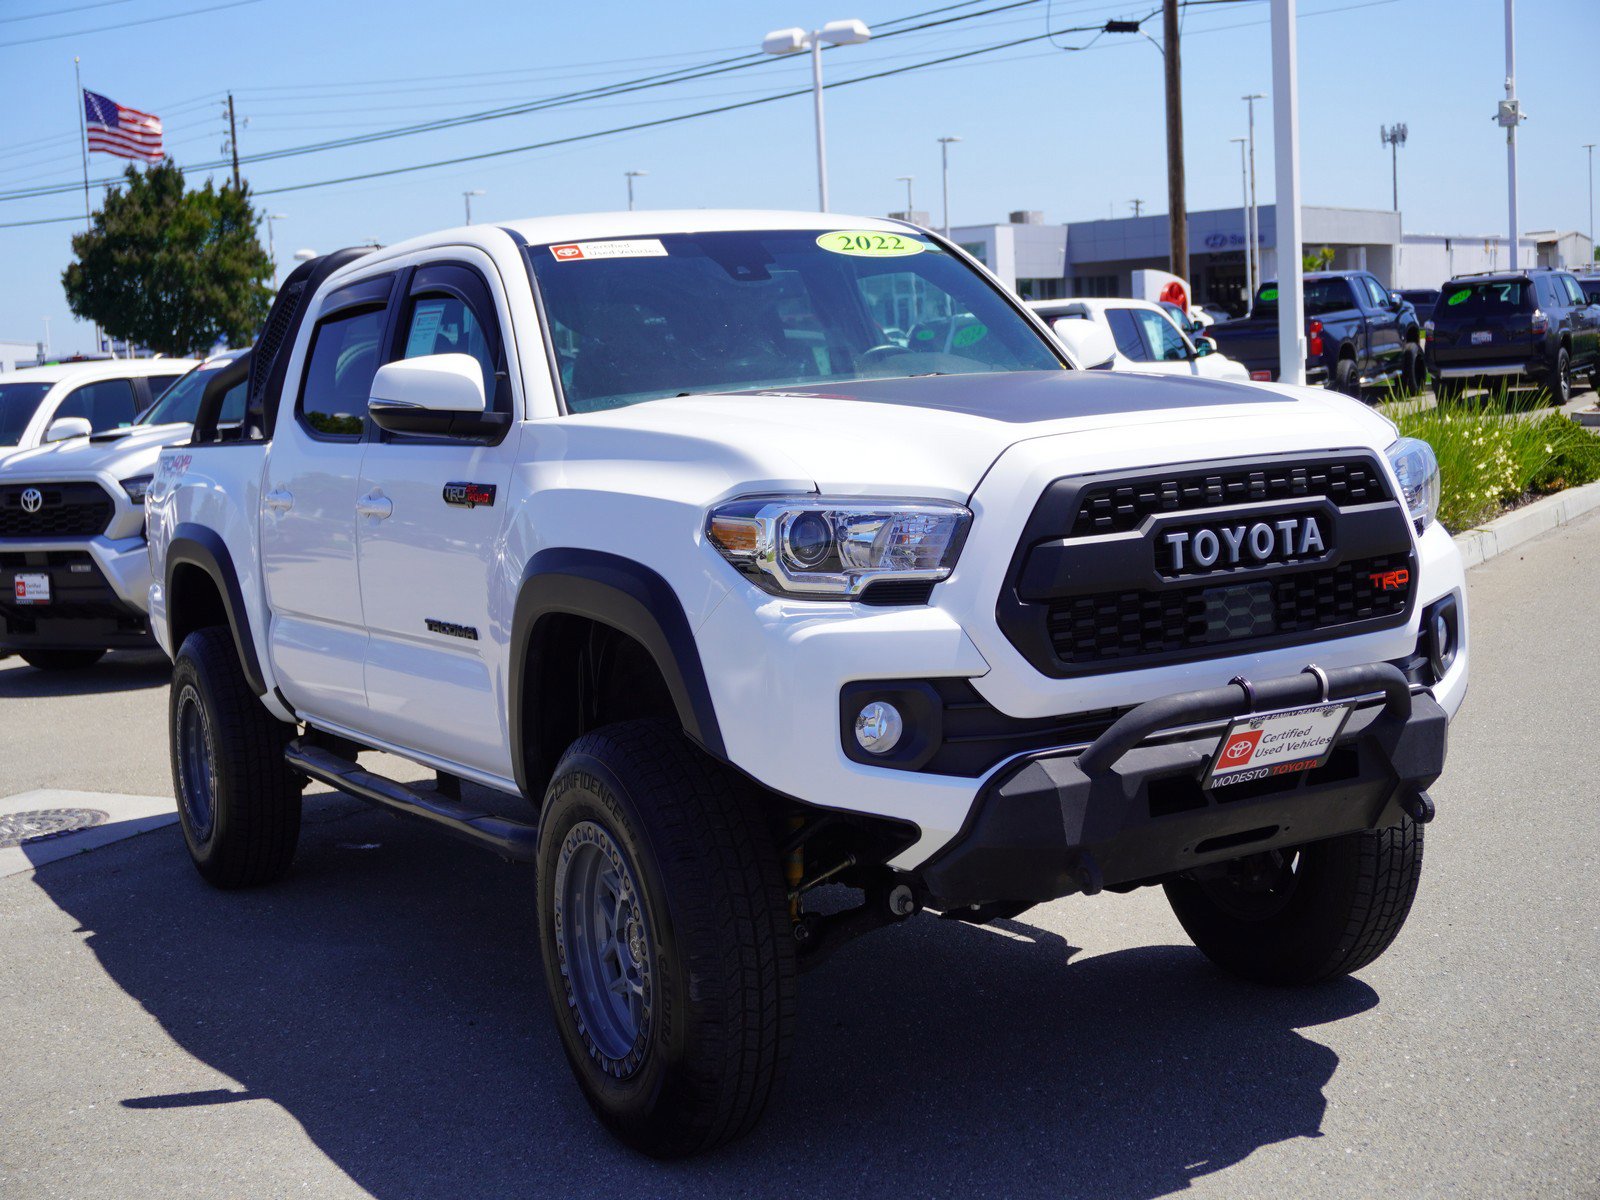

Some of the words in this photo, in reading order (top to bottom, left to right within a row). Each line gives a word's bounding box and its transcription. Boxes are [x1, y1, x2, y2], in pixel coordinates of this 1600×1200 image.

[837, 235, 905, 250] 2022
[444, 485, 466, 502] TRD
[1165, 517, 1325, 570] TOYOTA
[1369, 569, 1409, 590] TRD
[1271, 711, 1297, 720] FAMILY
[1262, 726, 1313, 744] Certified
[1255, 743, 1283, 758] Used
[1286, 736, 1332, 752] Vehicles
[1211, 768, 1269, 789] MODESTO
[1272, 760, 1317, 775] TOYOTA
